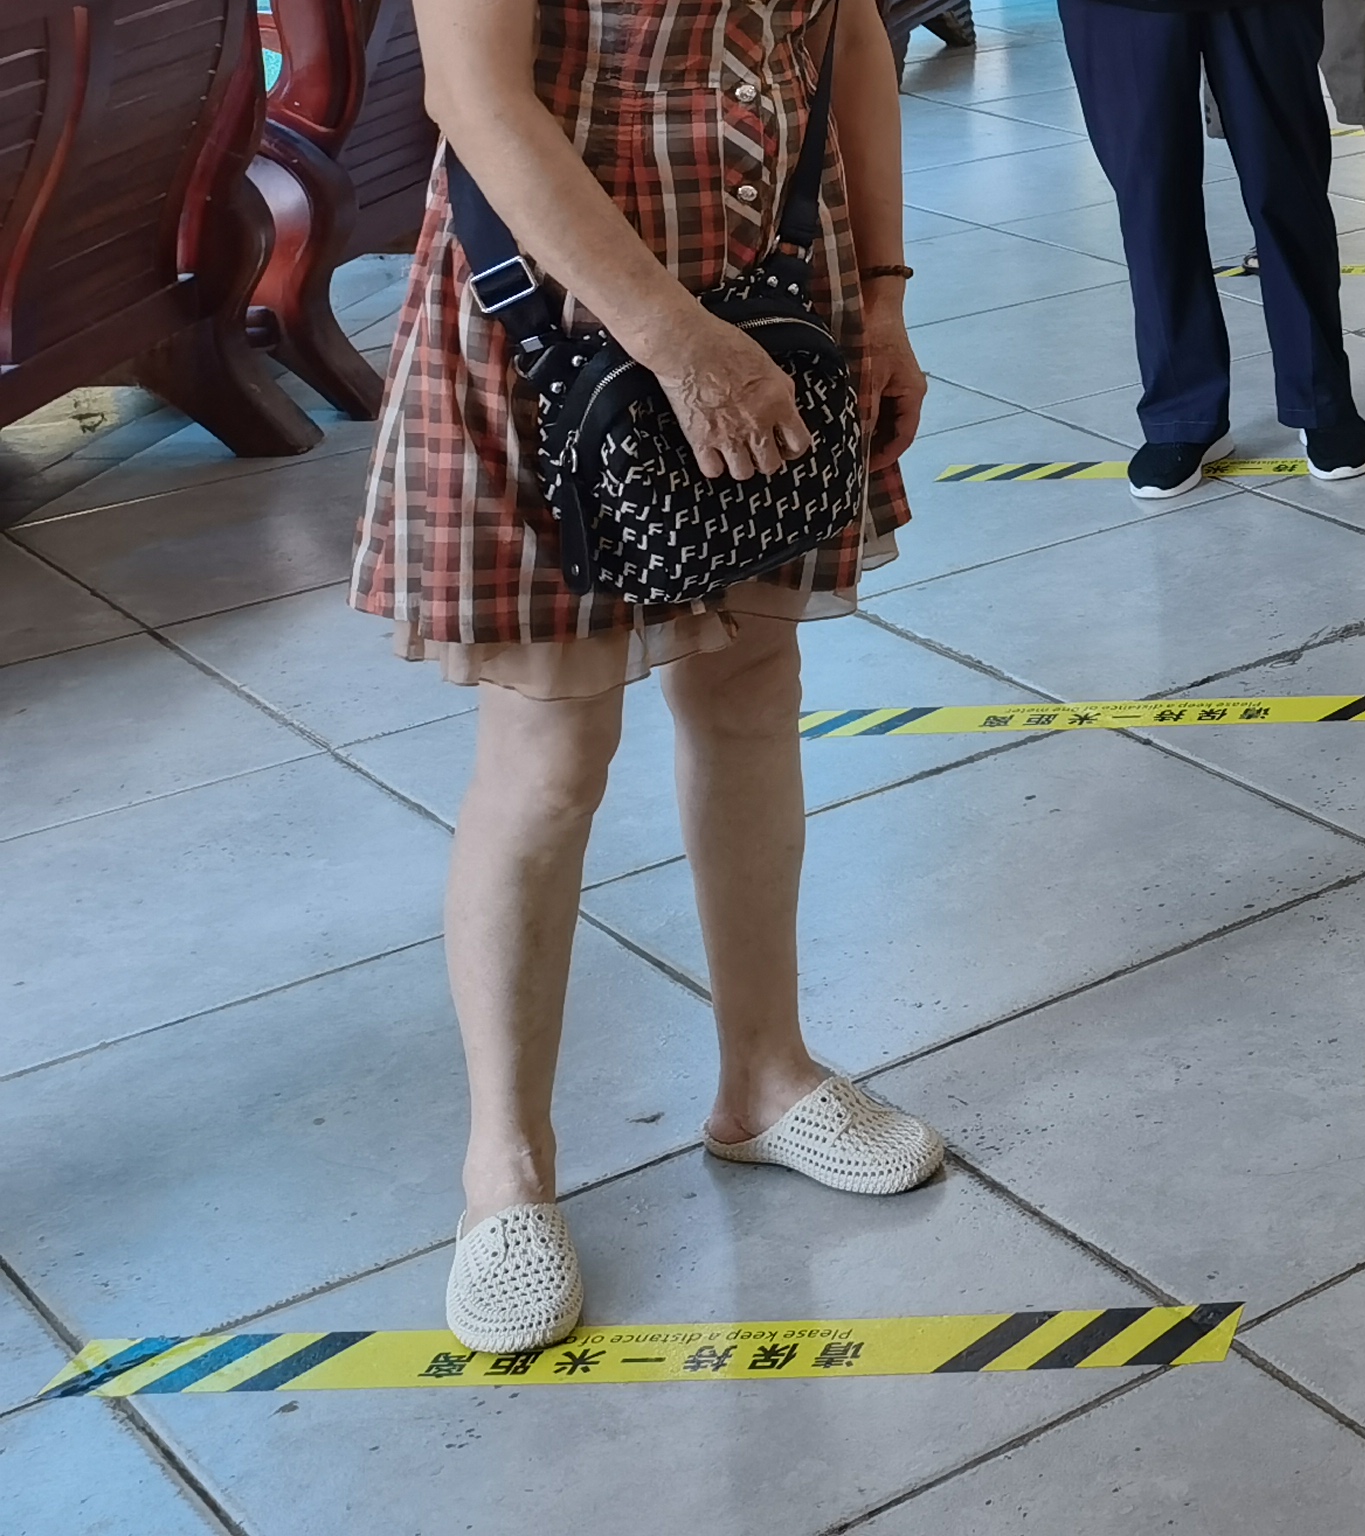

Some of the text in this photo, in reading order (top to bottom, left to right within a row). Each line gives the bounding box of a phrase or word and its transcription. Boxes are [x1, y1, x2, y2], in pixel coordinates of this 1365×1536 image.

[978, 707, 1270, 727] 请保持一米距离
[610, 1331, 702, 1345] distance
[726, 1328, 779, 1342] keep
[783, 1328, 853, 1340] Please
[418, 1341, 865, 1378] 请保持一米距离
